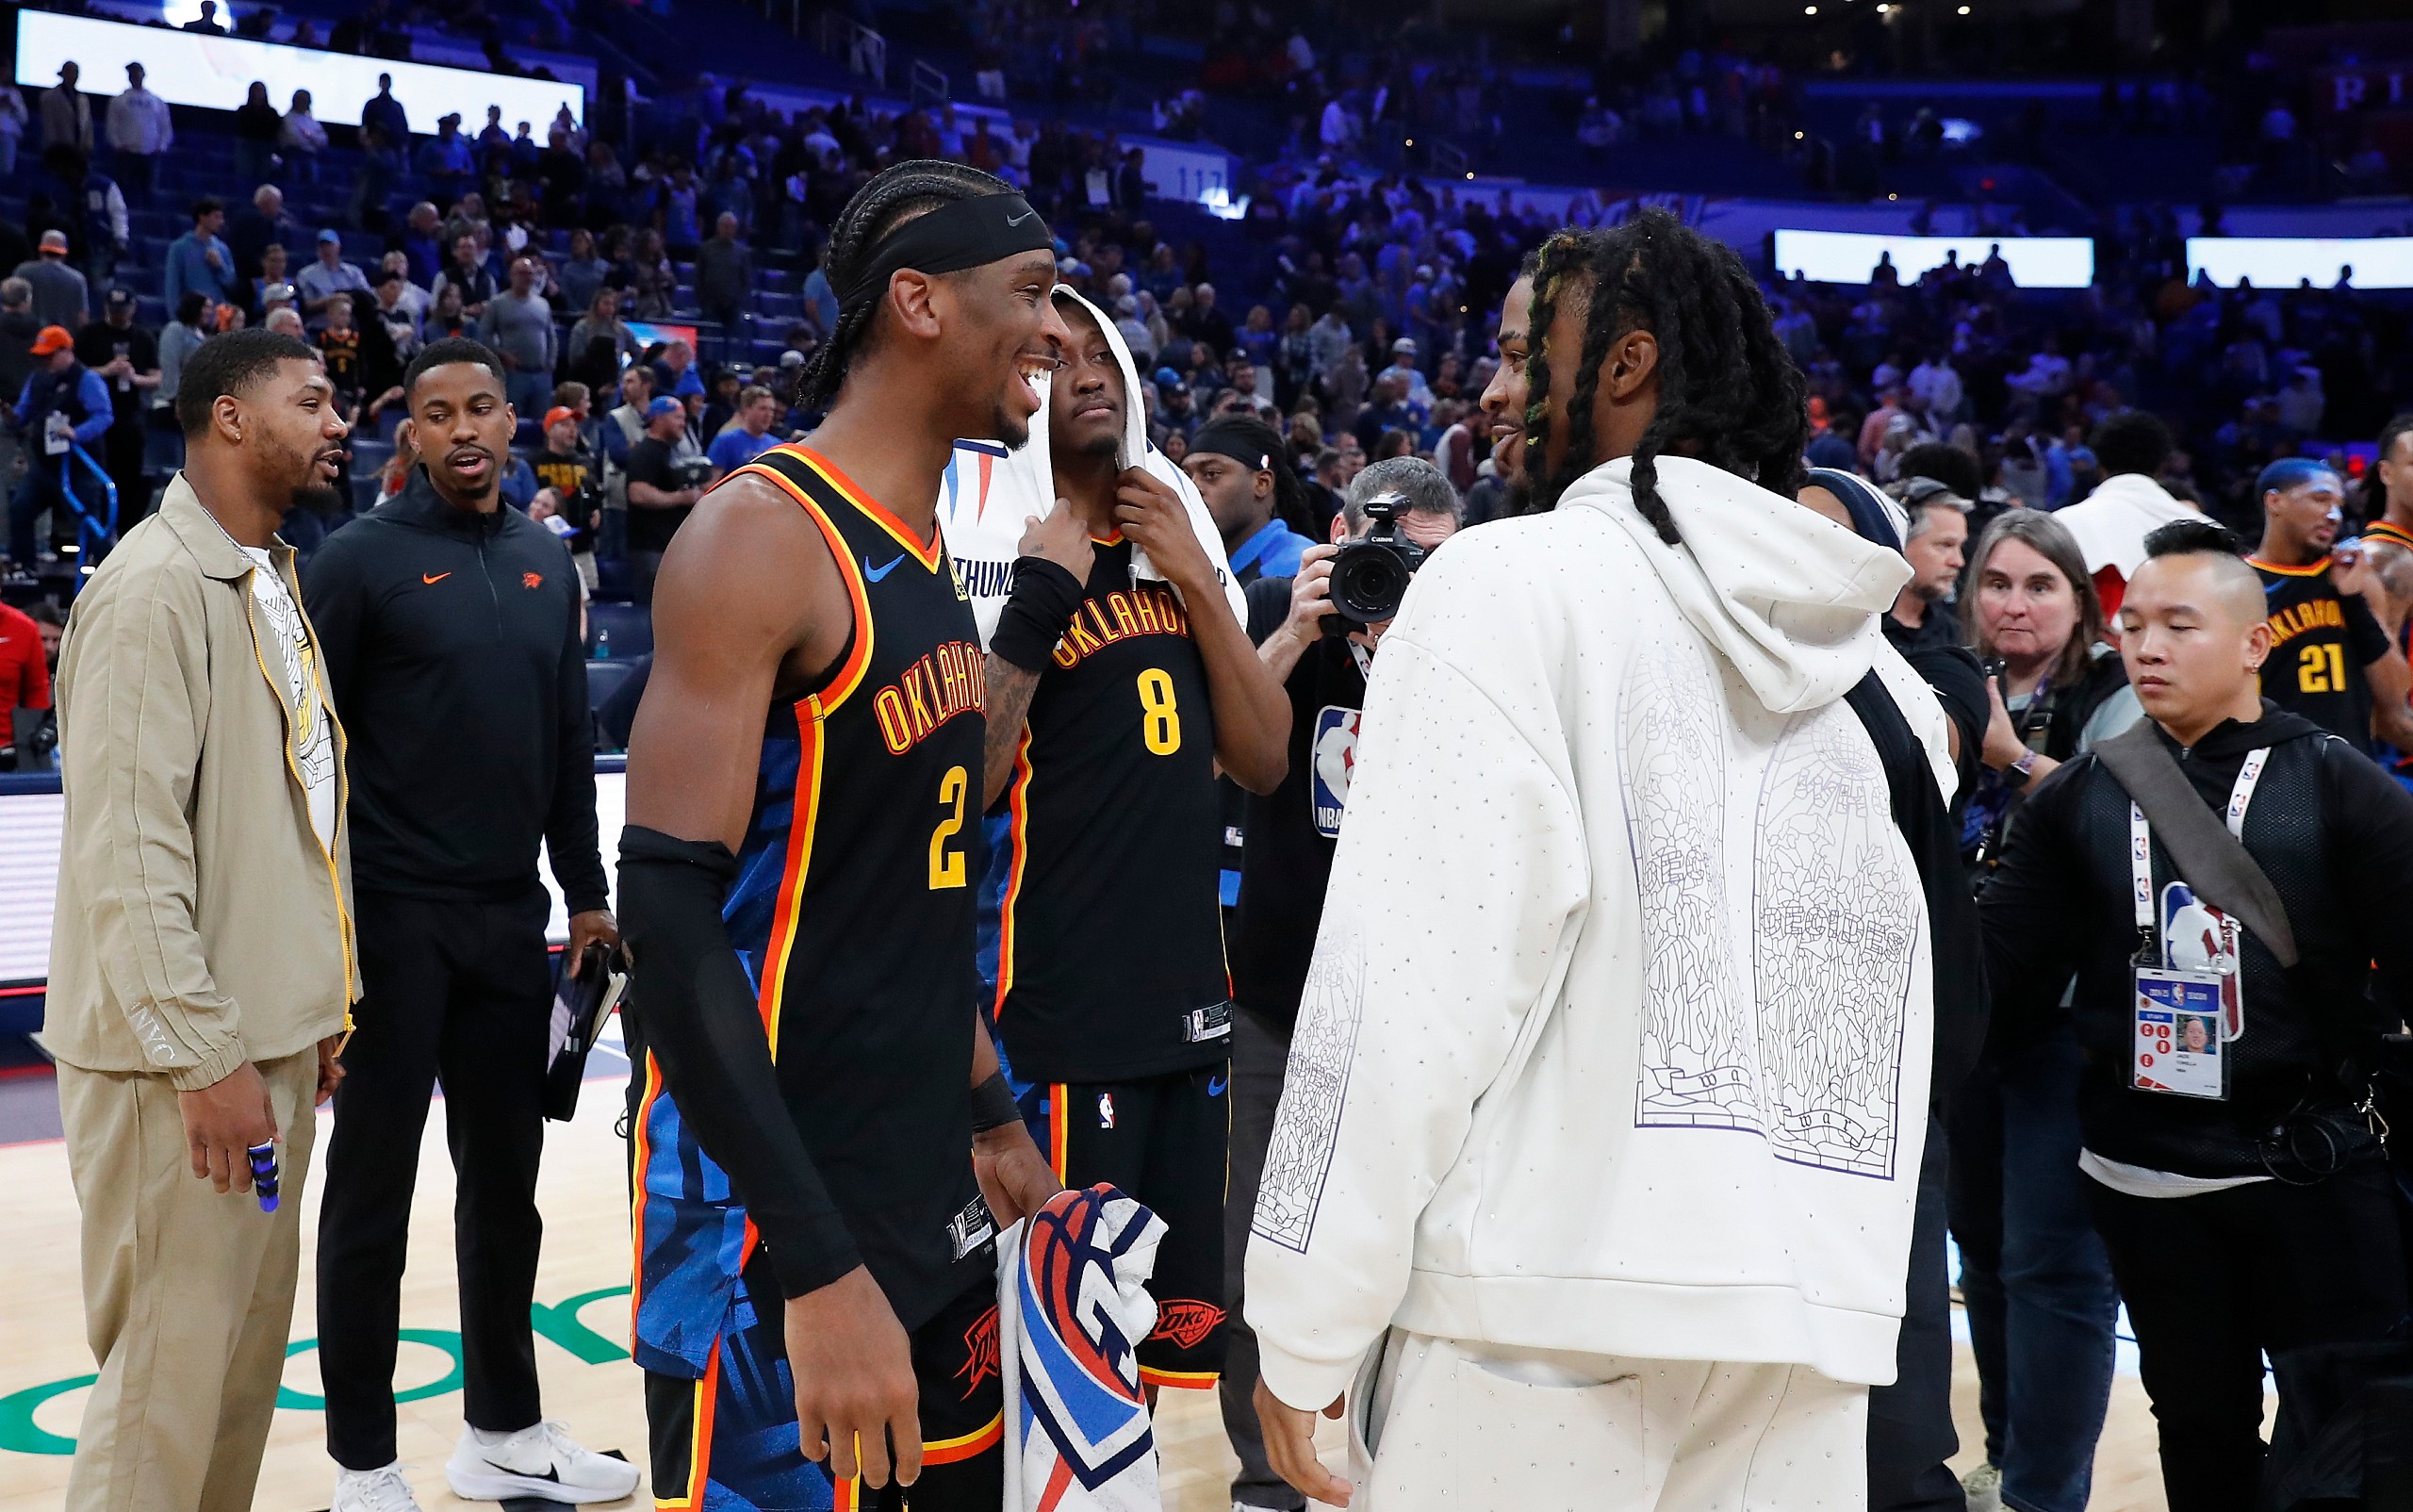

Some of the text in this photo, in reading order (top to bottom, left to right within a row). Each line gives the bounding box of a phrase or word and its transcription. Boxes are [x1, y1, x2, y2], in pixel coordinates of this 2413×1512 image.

[2298, 642, 2346, 693] 21
[1137, 667, 1181, 755] 8
[928, 765, 968, 890] 2
[1763, 905, 1905, 962] DECIDES
[1699, 1068, 1741, 1088] wa
[1798, 1112, 1852, 1132] war
[1158, 1307, 1206, 1333] OKC
